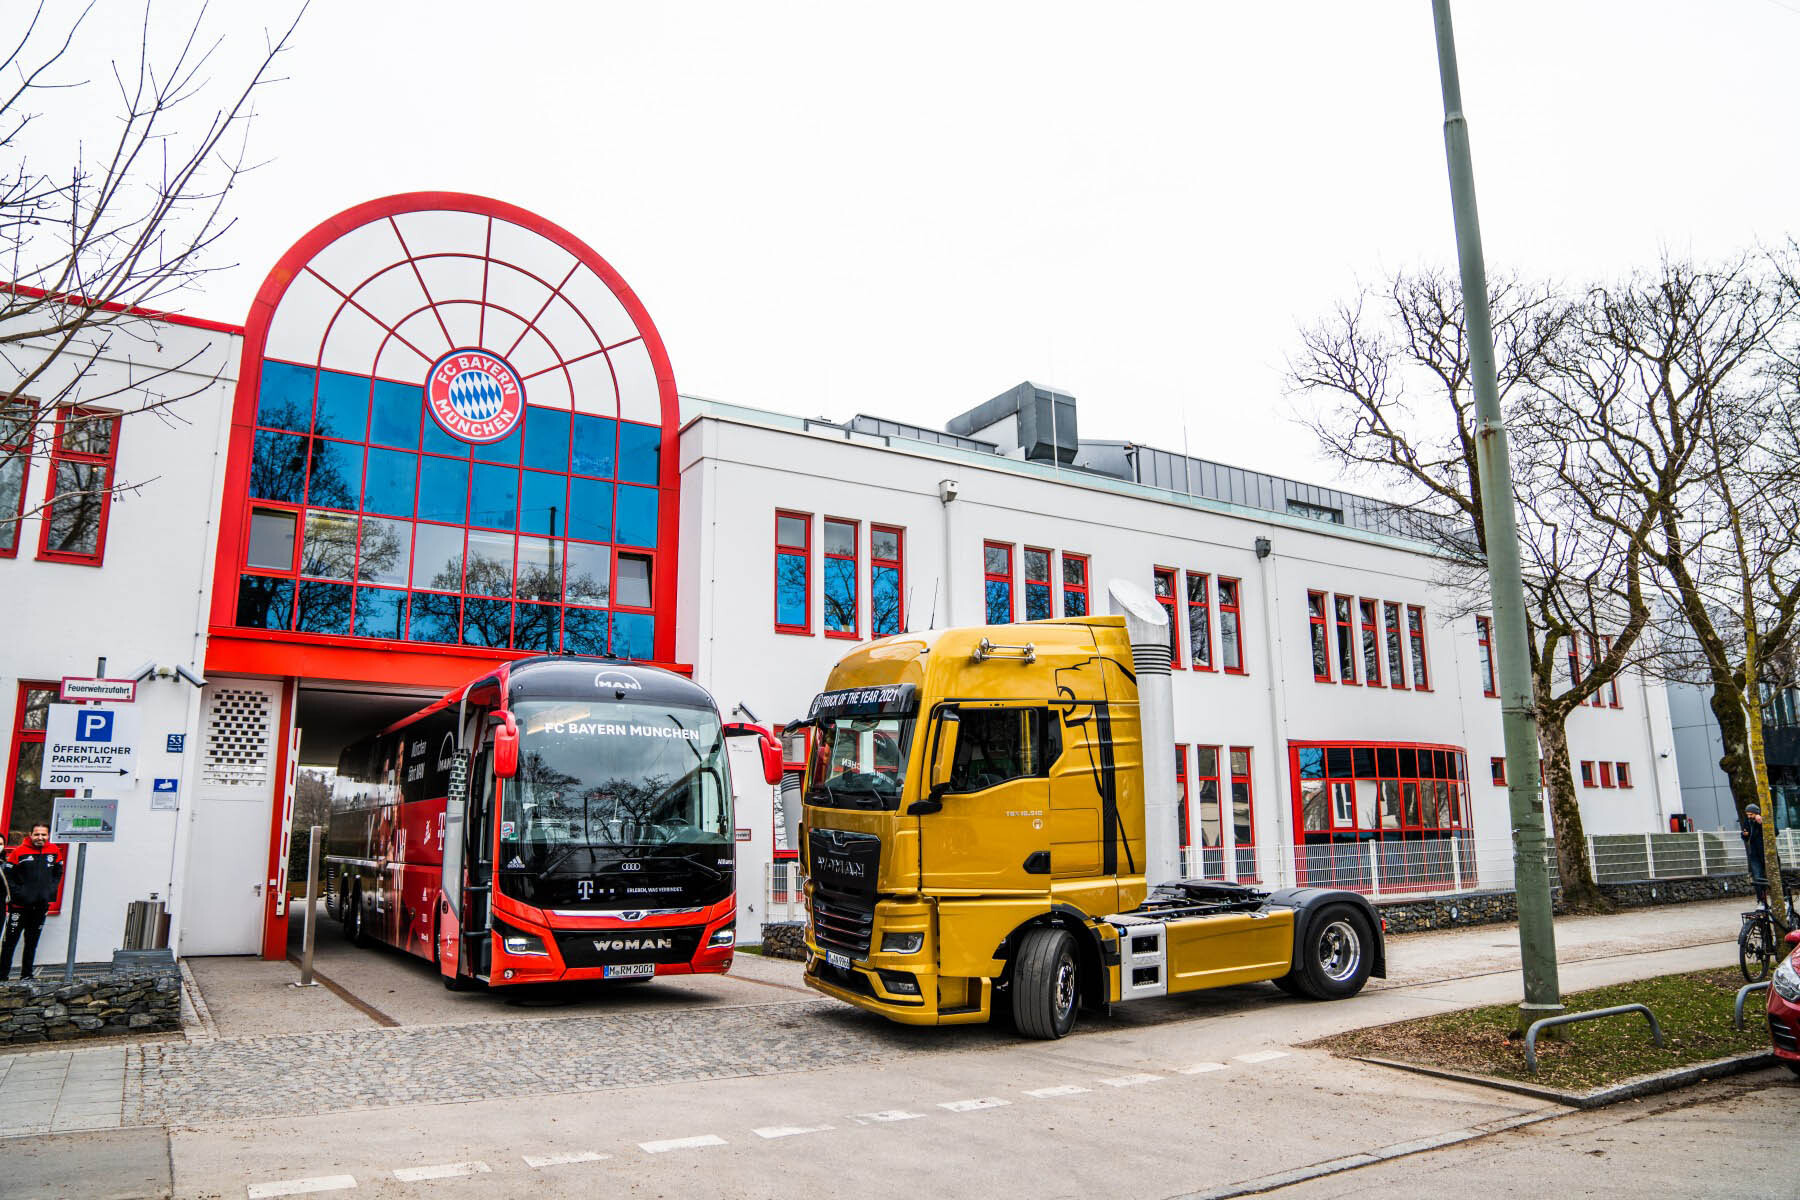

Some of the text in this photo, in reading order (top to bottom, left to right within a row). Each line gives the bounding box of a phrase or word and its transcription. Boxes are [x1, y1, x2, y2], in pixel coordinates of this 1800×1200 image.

[437, 357, 517, 395] FC BAYERN
[435, 398, 515, 436] MÜNCHEN
[67, 683, 131, 694] Feuerwehrzufahrt
[599, 680, 638, 690] MAN
[820, 689, 898, 708] TRUCK OF THE YEAR 2021
[85, 715, 106, 737] P
[544, 722, 700, 740] FC BAYERN MÜNCHEN
[169, 735, 182, 744] 53
[53, 744, 131, 754] ÖFFENTLICHER
[52, 755, 112, 764] PARKPLATZ
[49, 775, 71, 784] 200
[592, 938, 672, 951] WOMAN
[609, 964, 653, 976] M RM 2001
